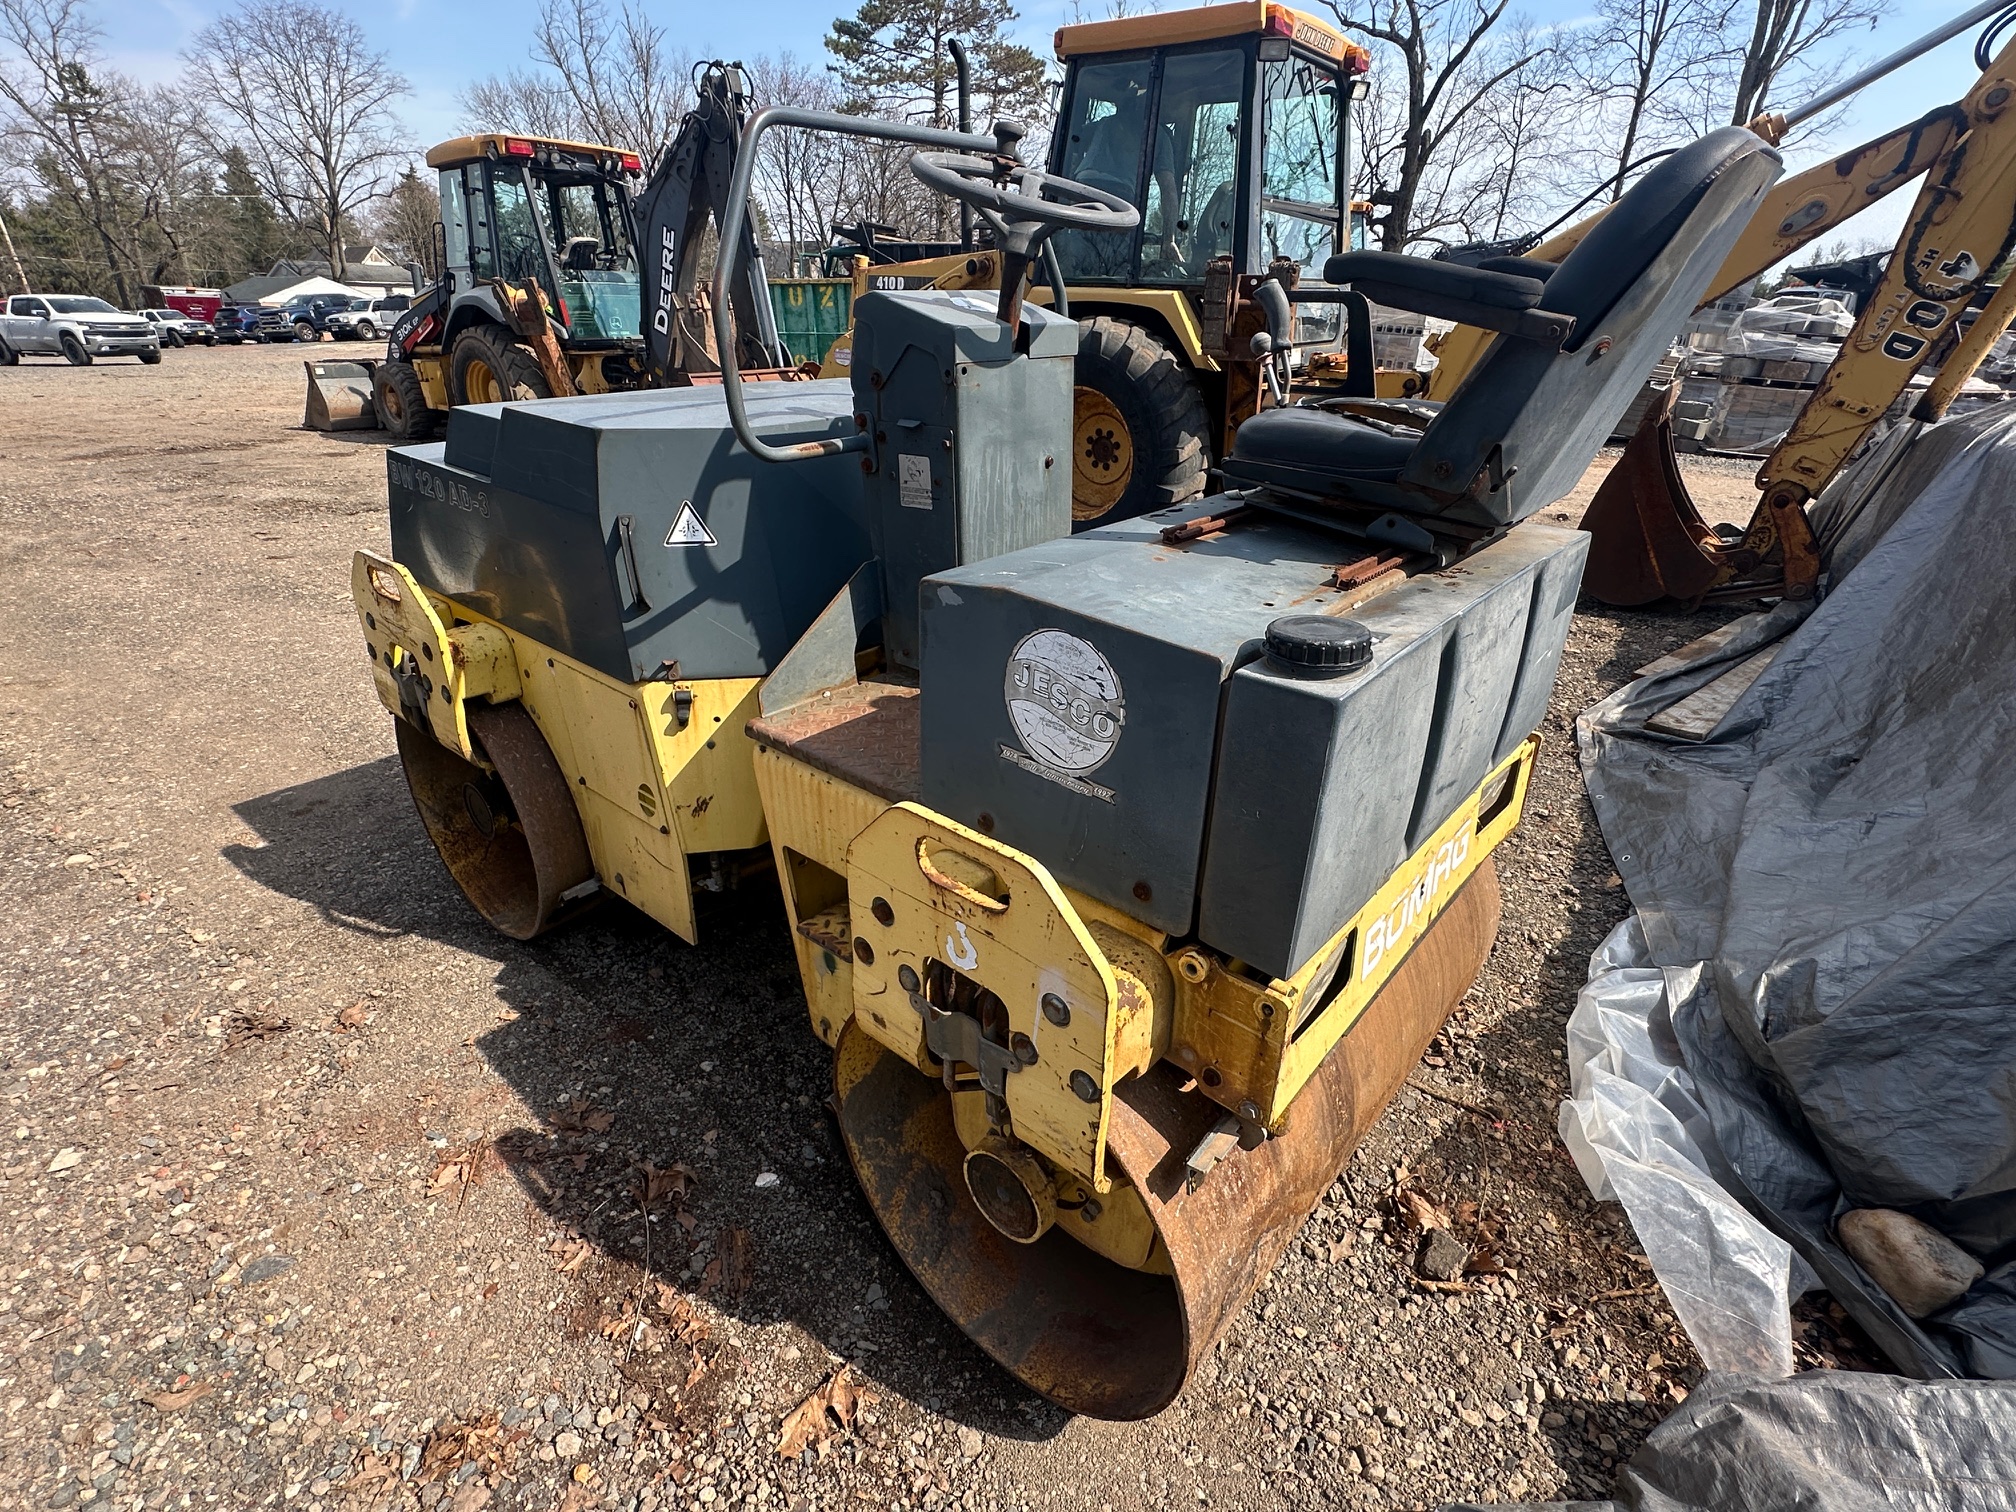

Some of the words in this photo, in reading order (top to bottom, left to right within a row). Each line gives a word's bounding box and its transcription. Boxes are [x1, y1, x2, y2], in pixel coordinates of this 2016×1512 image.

[1296, 23, 1317, 45] JOHN
[1314, 31, 1335, 54] DEERE
[654, 226, 675, 335] DEERE
[397, 320, 413, 340] 310K
[389, 459, 415, 491] BW
[415, 469, 445, 501] 120
[449, 481, 490, 518] AD-3
[1014, 663, 1115, 738] JESCO
[1362, 818, 1473, 982] BOMAG
